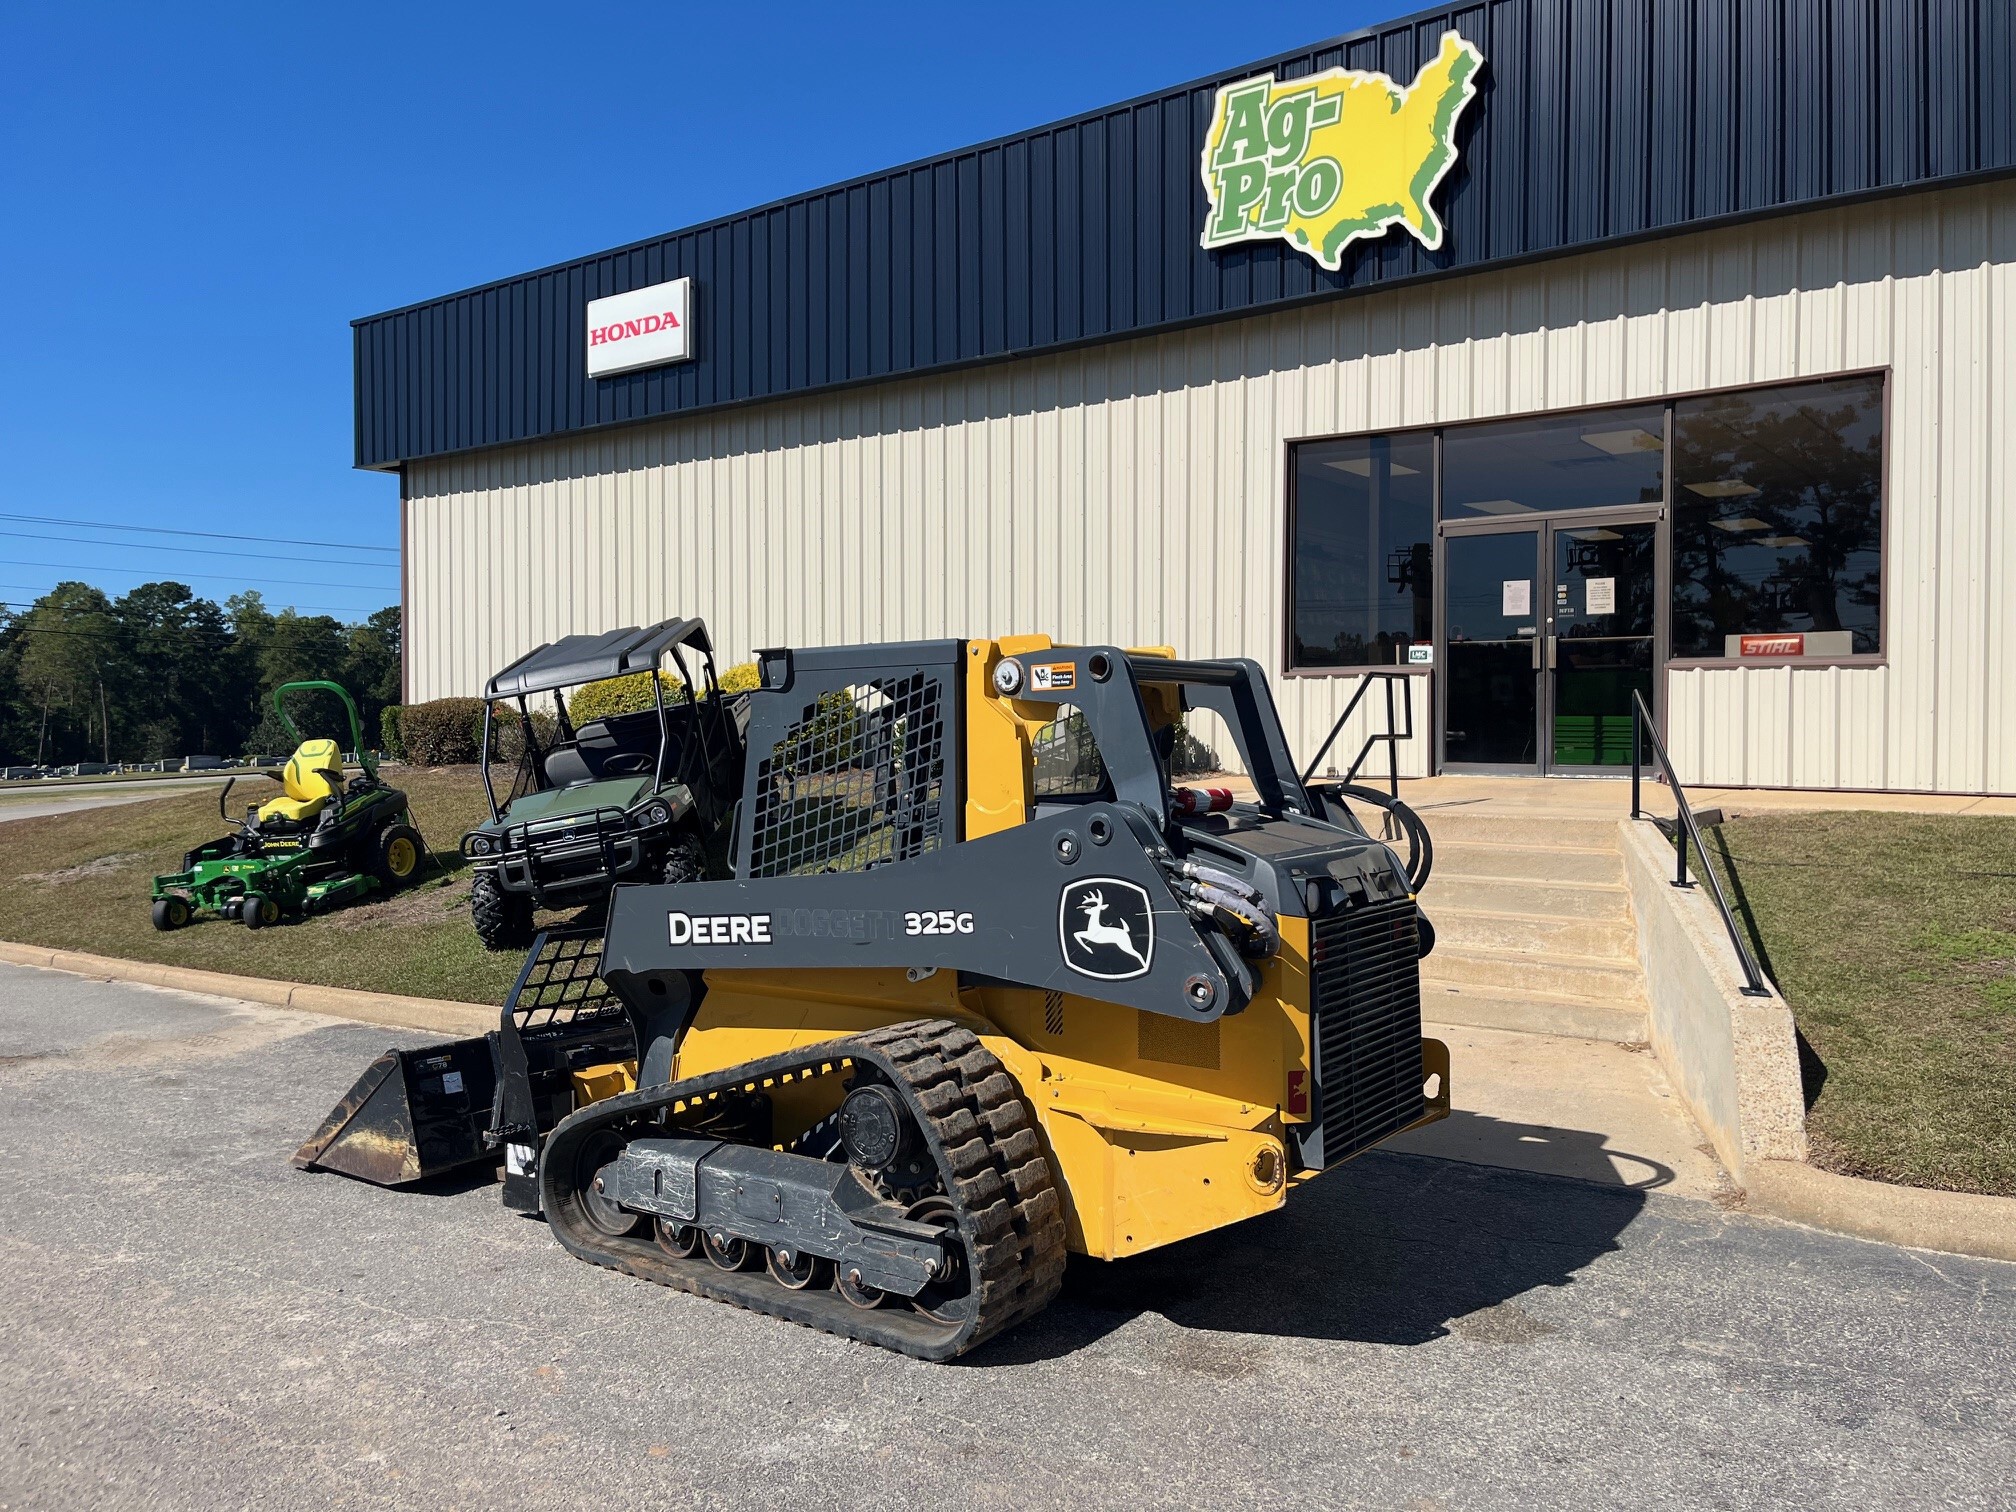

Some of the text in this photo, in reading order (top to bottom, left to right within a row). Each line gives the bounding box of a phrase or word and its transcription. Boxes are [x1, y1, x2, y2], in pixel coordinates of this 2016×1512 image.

[1215, 86, 1342, 168] Ag-
[1213, 158, 1342, 239] Pro
[590, 311, 681, 347] HONDA
[1744, 641, 1797, 654] STIHL
[668, 911, 772, 945] DEERE
[904, 911, 974, 935] 325G
